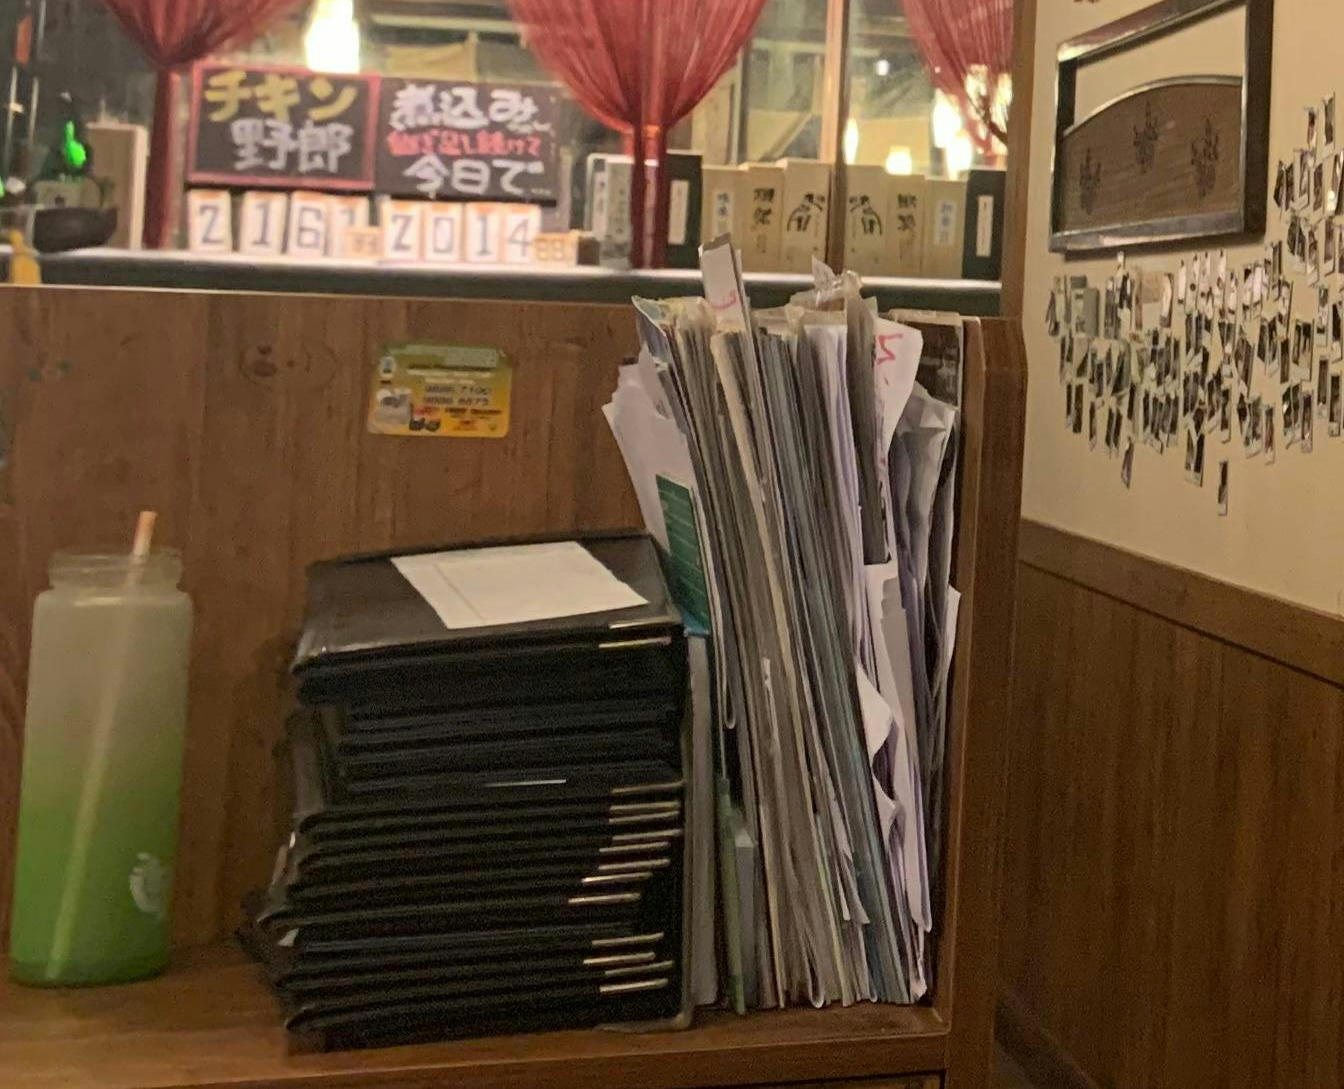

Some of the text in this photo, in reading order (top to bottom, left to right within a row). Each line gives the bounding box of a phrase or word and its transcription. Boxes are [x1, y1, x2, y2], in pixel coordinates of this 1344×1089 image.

[205, 67, 359, 124] チキン
[230, 116, 356, 174] 野郎
